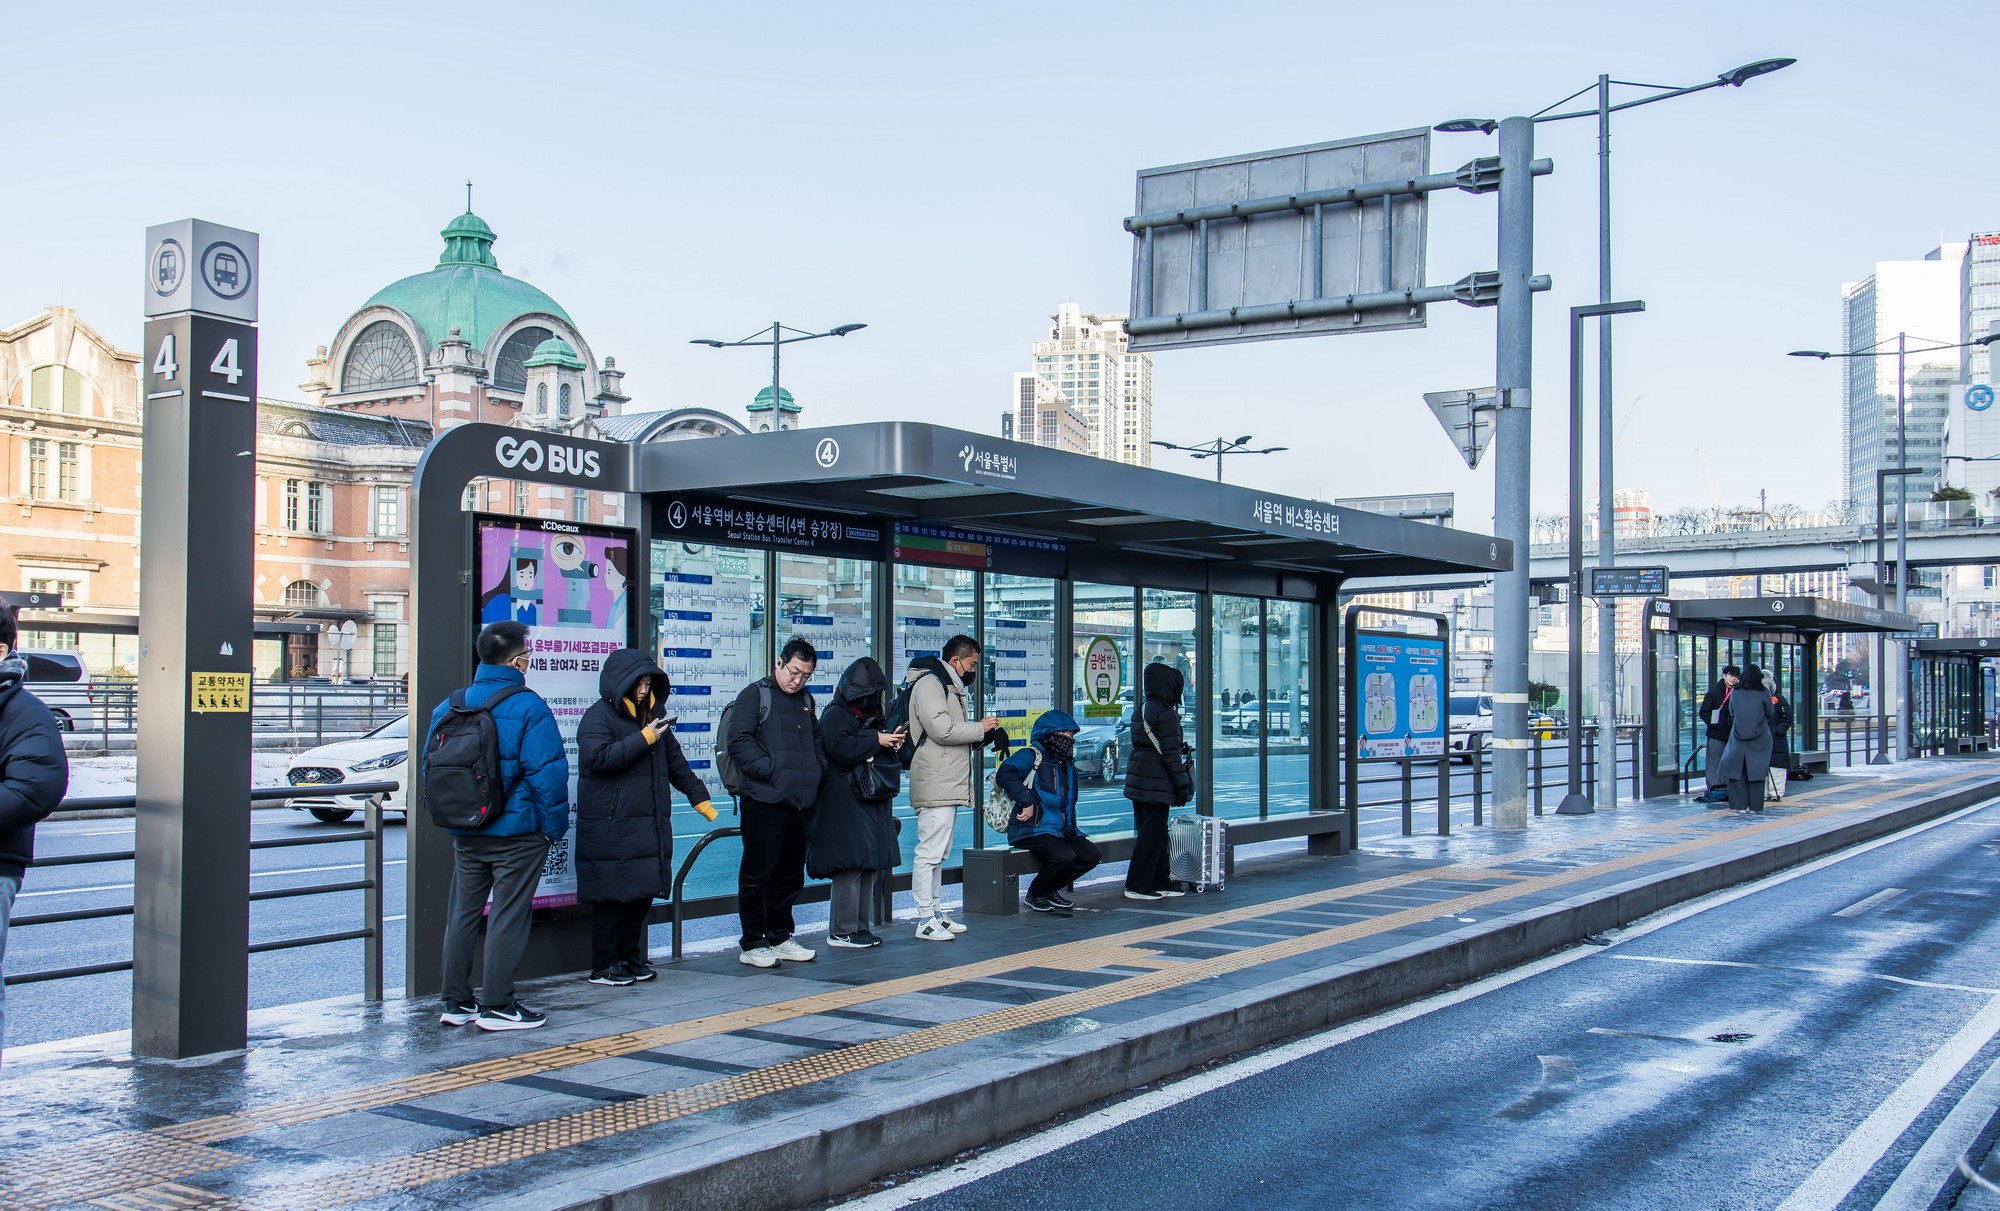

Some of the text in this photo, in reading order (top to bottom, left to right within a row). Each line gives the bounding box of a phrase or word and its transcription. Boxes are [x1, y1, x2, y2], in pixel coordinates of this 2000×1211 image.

[153, 334, 179, 380] 4
[210, 338, 243, 384] 4
[495, 436, 601, 478] GO BUS
[975, 451, 1017, 474] 서울특별시
[541, 520, 579, 533] JCDecaux
[691, 505, 806, 536] 서울역버스환승센터(4번
[810, 519, 843, 541] 승강장)
[1253, 500, 1340, 535] 서울역 버스환승센터
[727, 530, 742, 539] Seoul
[742, 531, 761, 542] Station
[761, 534, 771, 542] Bus
[772, 535, 792, 545] Transfer
[793, 537, 810, 546] Center
[550, 658, 579, 671] 참여자
[581, 659, 600, 672] 모집
[1090, 653, 1106, 670] 금연
[198, 676, 245, 687] 교통약자석
